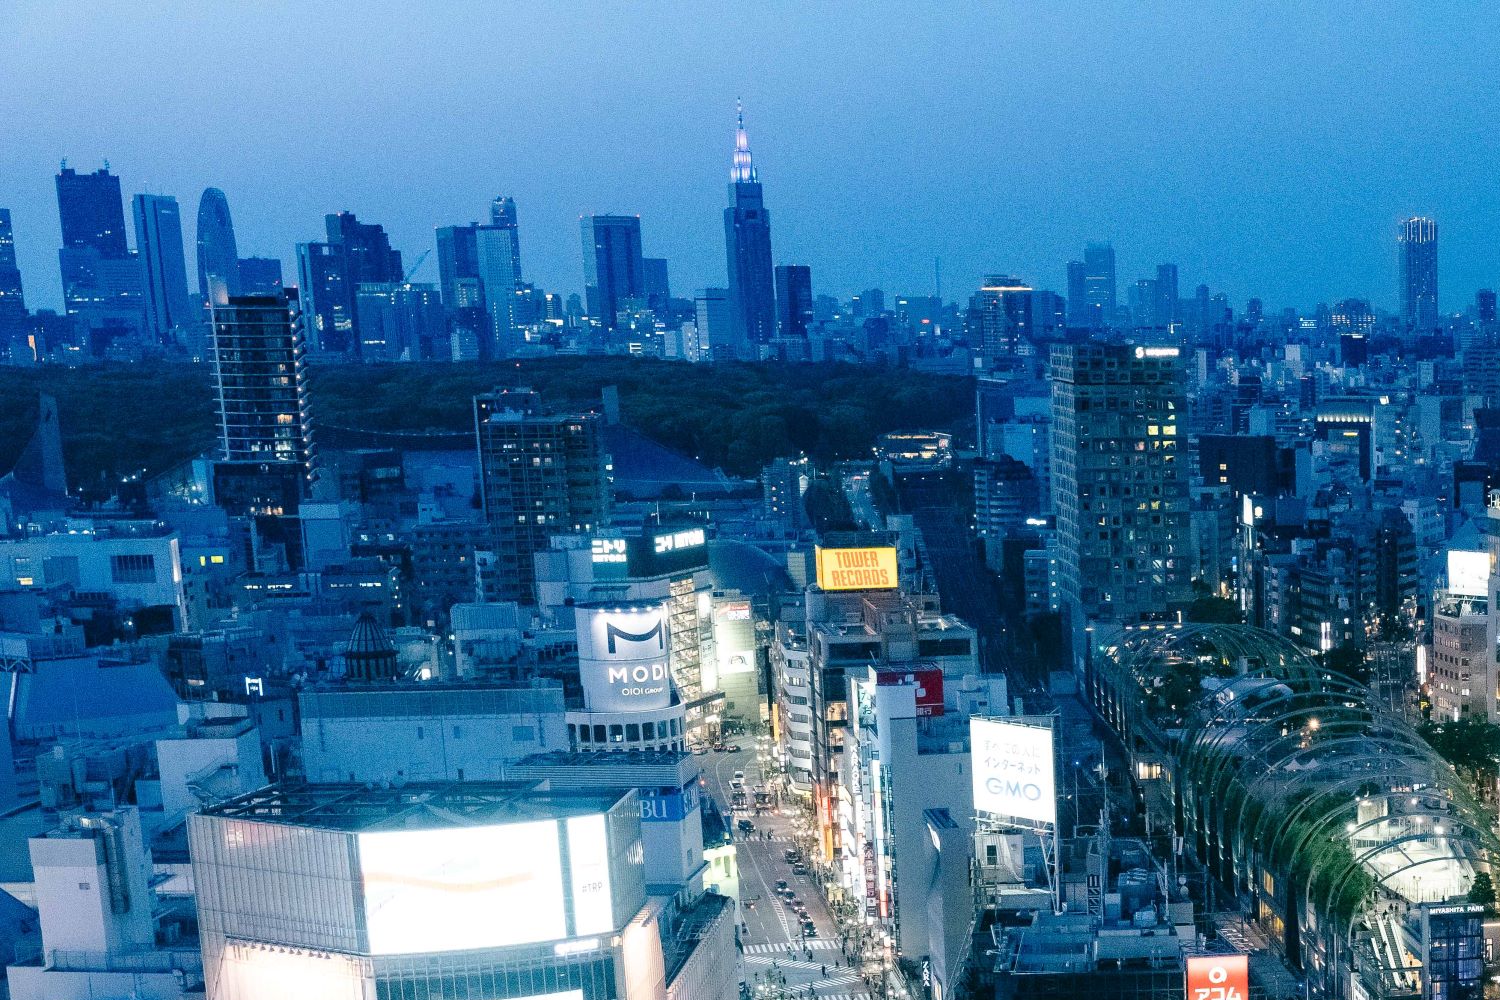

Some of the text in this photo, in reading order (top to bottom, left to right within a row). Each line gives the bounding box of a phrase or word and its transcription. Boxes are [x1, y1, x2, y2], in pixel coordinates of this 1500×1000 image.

[835, 551, 879, 568] TOWER
[831, 569, 889, 587] RECORDS
[608, 662, 668, 684] MODI
[985, 756, 1041, 775] インターネット
[986, 777, 1042, 801] GMO
[1430, 906, 1464, 915] MIYASHITA
